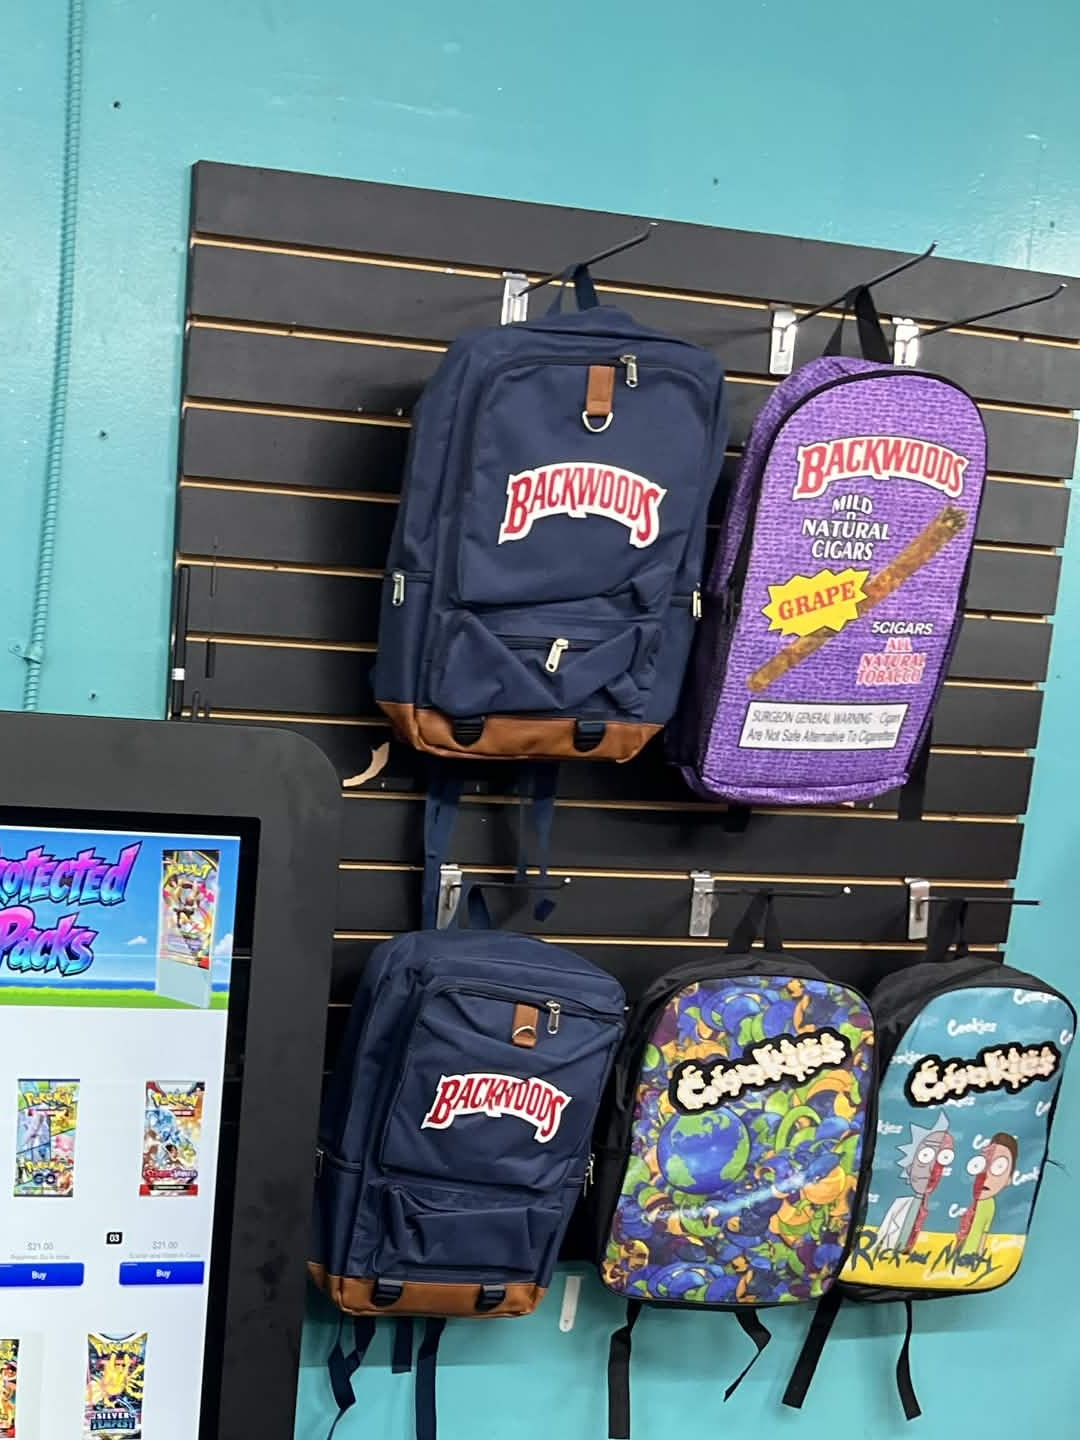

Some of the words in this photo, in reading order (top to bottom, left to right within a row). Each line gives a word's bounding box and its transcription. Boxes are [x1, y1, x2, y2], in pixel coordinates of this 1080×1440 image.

[794, 437, 968, 498] BACKWOODS
[499, 463, 665, 546] BACKWOODS
[831, 494, 874, 515] MILD
[801, 518, 890, 541] NATURAL
[811, 539, 874, 561] CIGARS
[777, 580, 857, 621] GRAPE
[871, 621, 934, 635] 5CIGARS
[886, 637, 912, 651] ALL
[861, 653, 926, 668] NATURAL
[856, 667, 924, 685] TOBACCO
[752, 709, 793, 724] SURGEON
[794, 711, 830, 724] GENERAL
[747, 727, 762, 741] Are
[764, 728, 781, 741] Not
[782, 729, 801, 743] Safe
[847, 730, 858, 743] To
[677, 1032, 846, 1110] Cookies
[910, 1046, 1058, 1104] Cookies
[31, 1270, 47, 1281] Buy
[155, 1268, 171, 1279] Buy
